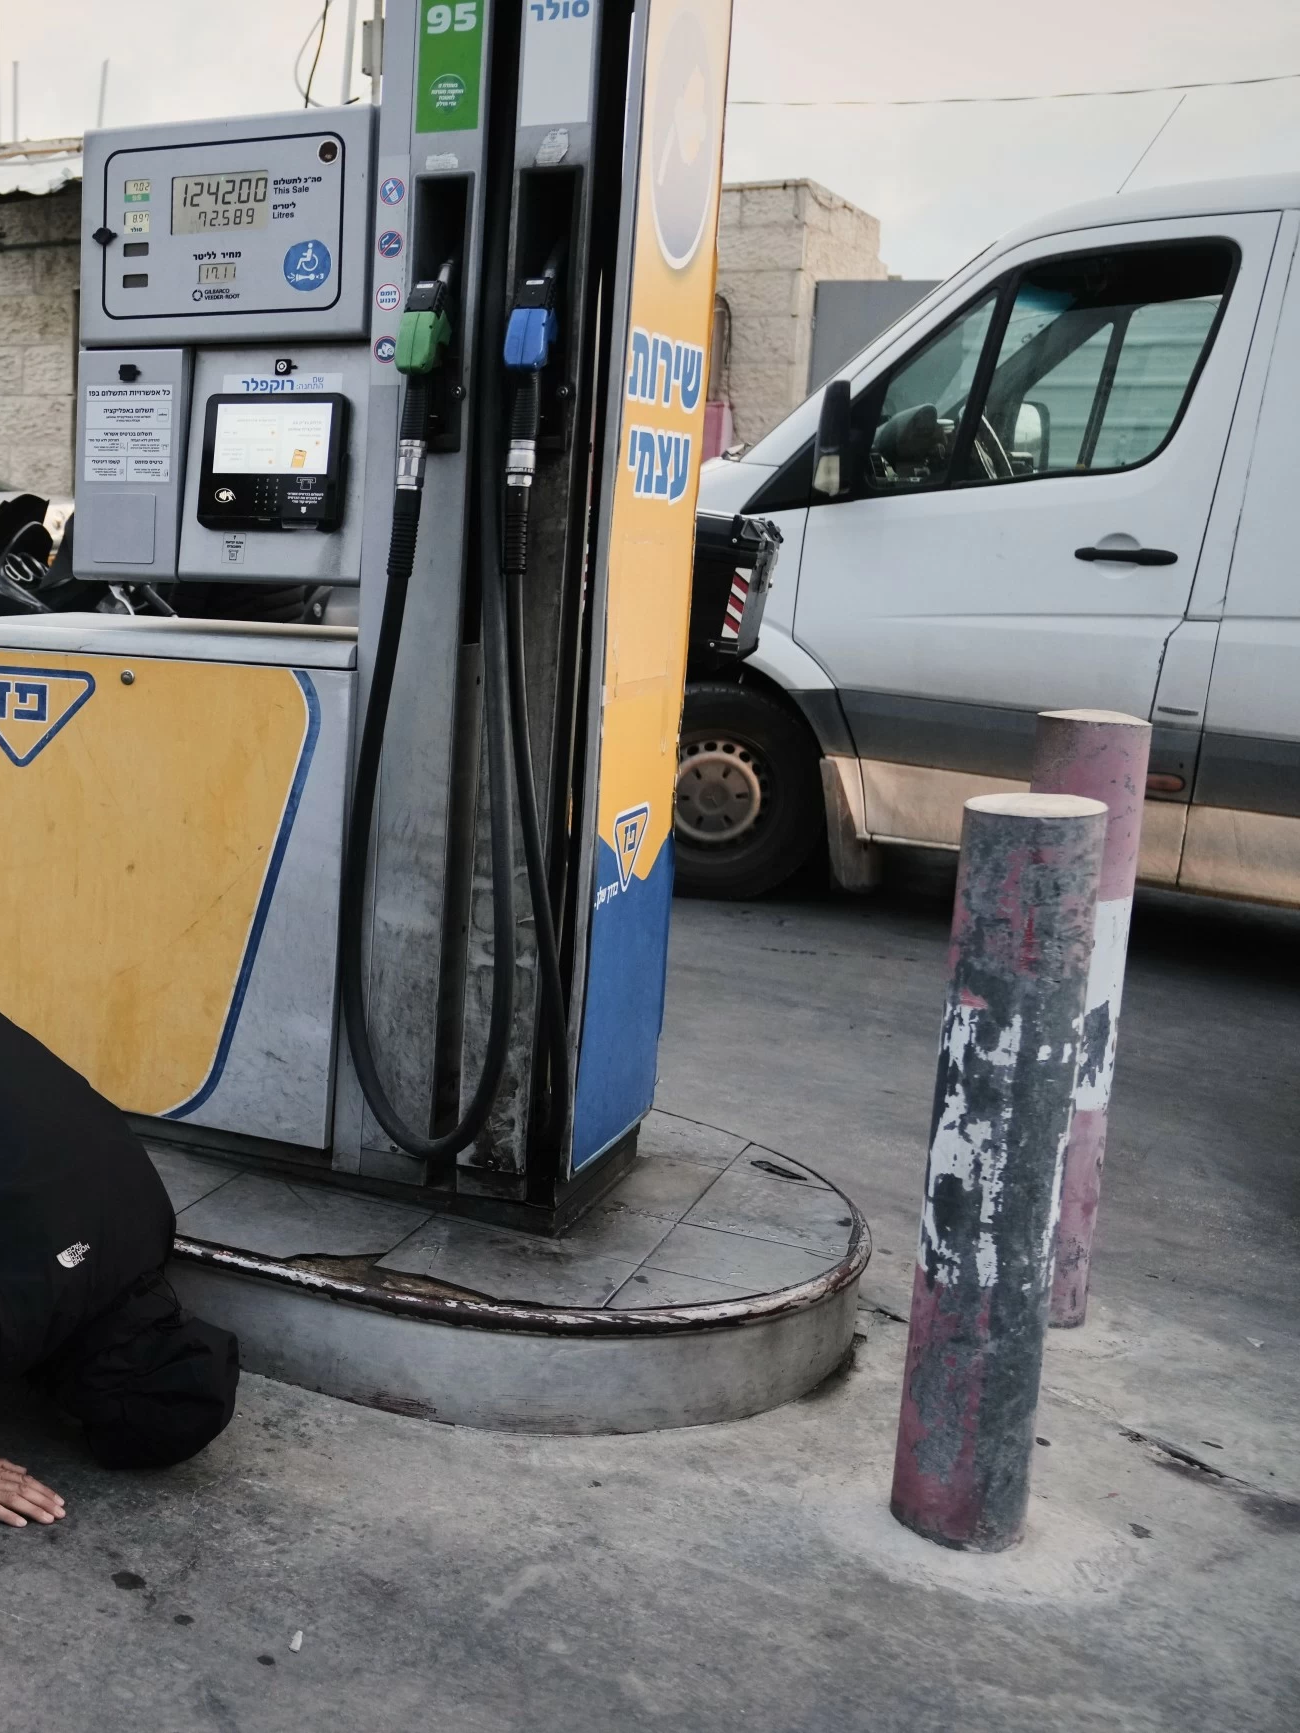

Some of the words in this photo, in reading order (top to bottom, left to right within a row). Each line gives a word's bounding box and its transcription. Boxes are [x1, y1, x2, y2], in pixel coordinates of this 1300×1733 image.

[427, 2, 478, 34] 95
[531, 0, 590, 21] סולר
[273, 177, 302, 186] לתשלום
[183, 177, 268, 208] 1242.00
[273, 187, 290, 195] This
[292, 185, 310, 194] Sale
[272, 201, 296, 210] ליטרים
[198, 208, 254, 228] 72.589
[272, 212, 295, 220] Litres
[192, 251, 217, 261] לליטר
[220, 251, 242, 259] מחיר
[628, 328, 704, 412] שירות
[241, 378, 295, 394] רוקפלר
[312, 376, 324, 384] שם
[129, 389, 161, 397] אפשרויות
[628, 427, 692, 503] עצמי
[623, 821, 638, 854] פז
[69, 1243, 91, 1260] NORTH
